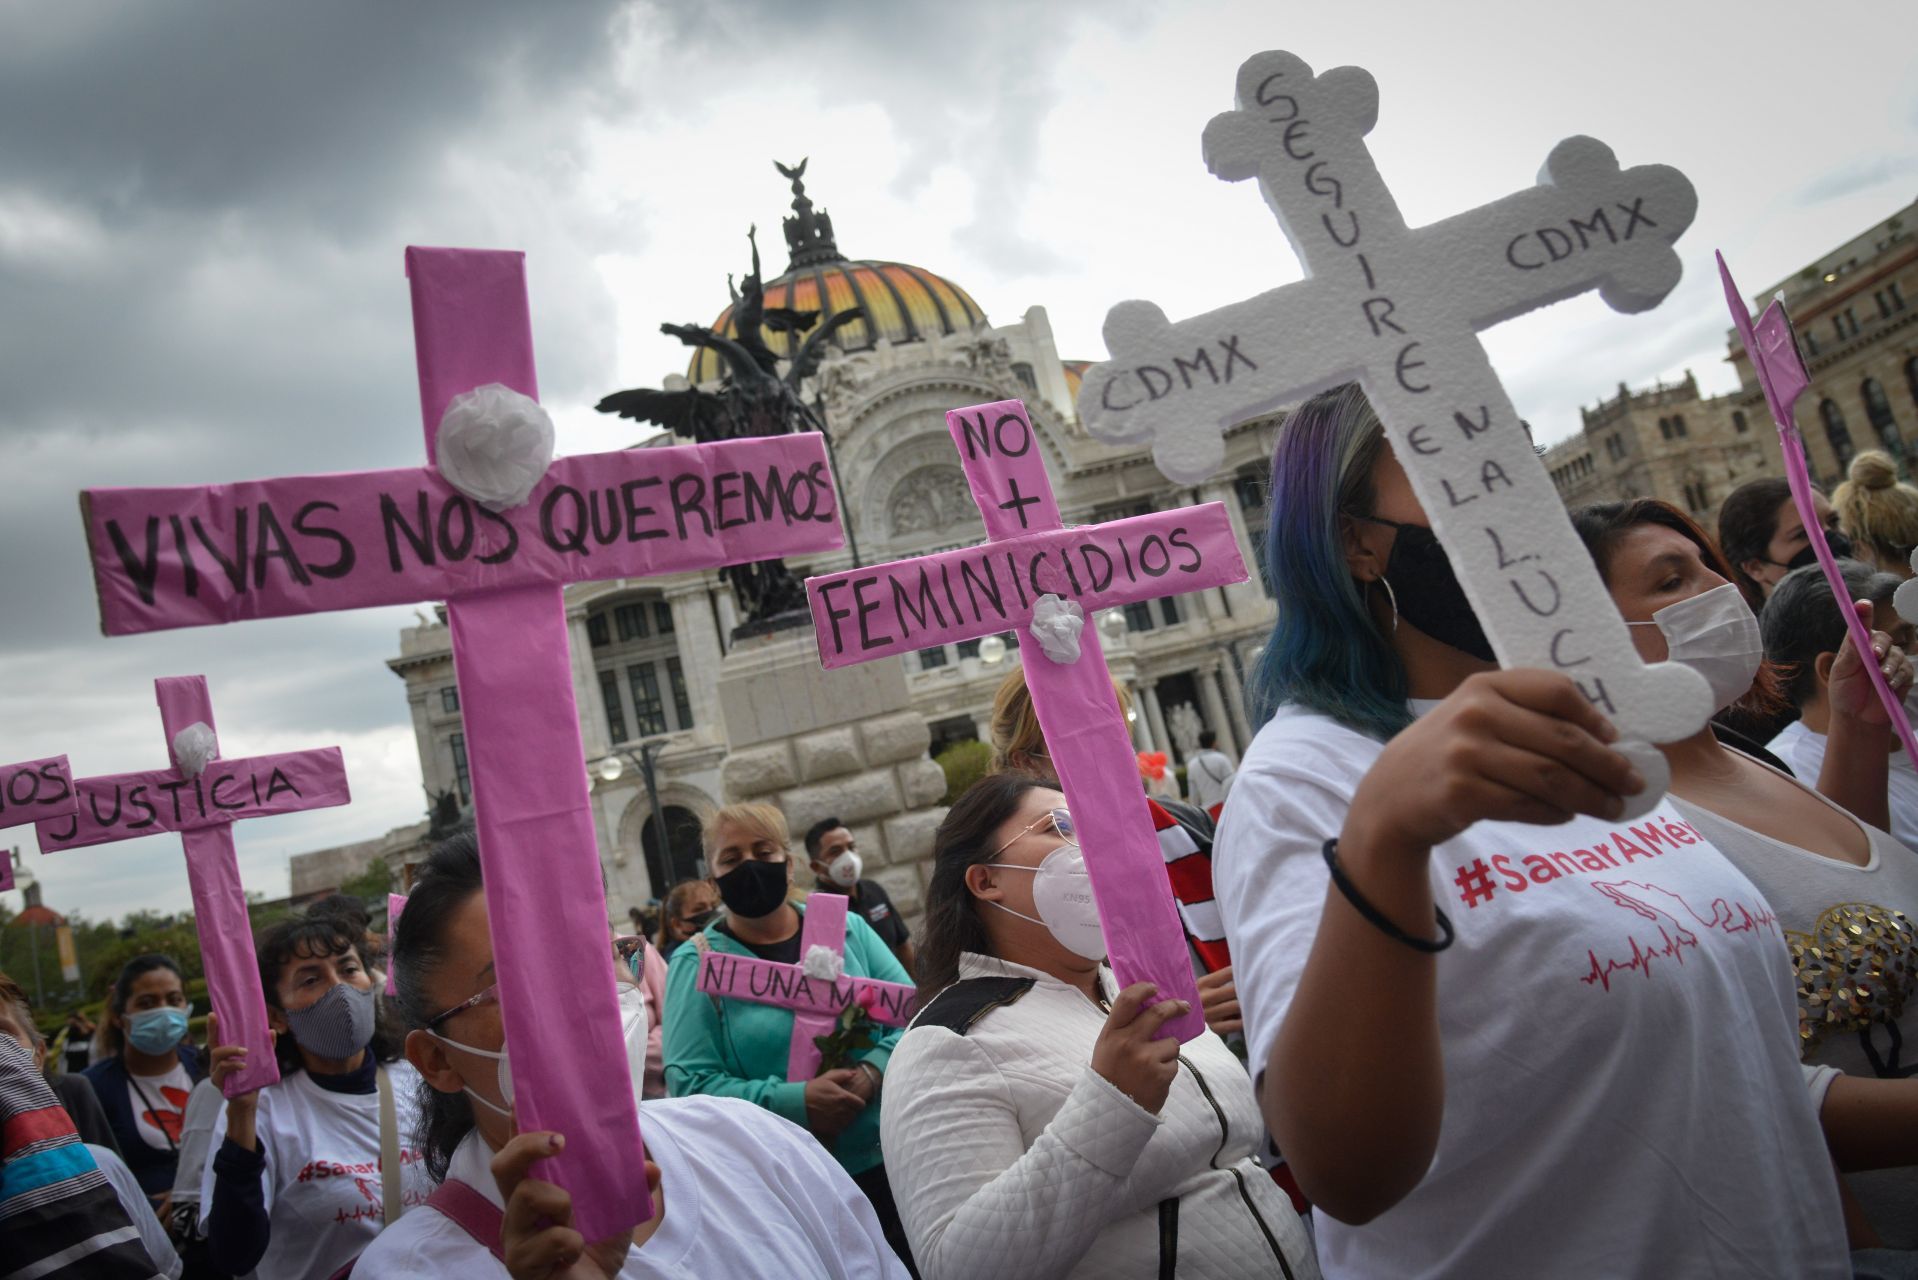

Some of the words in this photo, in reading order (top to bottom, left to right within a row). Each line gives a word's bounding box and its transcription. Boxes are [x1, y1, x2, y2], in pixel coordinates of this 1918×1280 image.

[1506, 197, 1658, 271] CDMX
[1101, 335, 1258, 412] CDMX
[959, 412, 1031, 460] NO
[1408, 405, 1492, 456] EN
[1441, 459, 1513, 508] LA
[104, 501, 356, 606] VIVAS
[379, 490, 519, 572] NOS
[539, 461, 837, 557] QUEREMOS
[818, 527, 1202, 654] FEMINICIDIOS
[0, 763, 70, 813] OS
[50, 766, 302, 841] JUSTICIA
[1063, 892, 1091, 904] KN95
[703, 956, 737, 992] NI
[750, 966, 816, 1005] UNA
[829, 981, 916, 1021] MN
